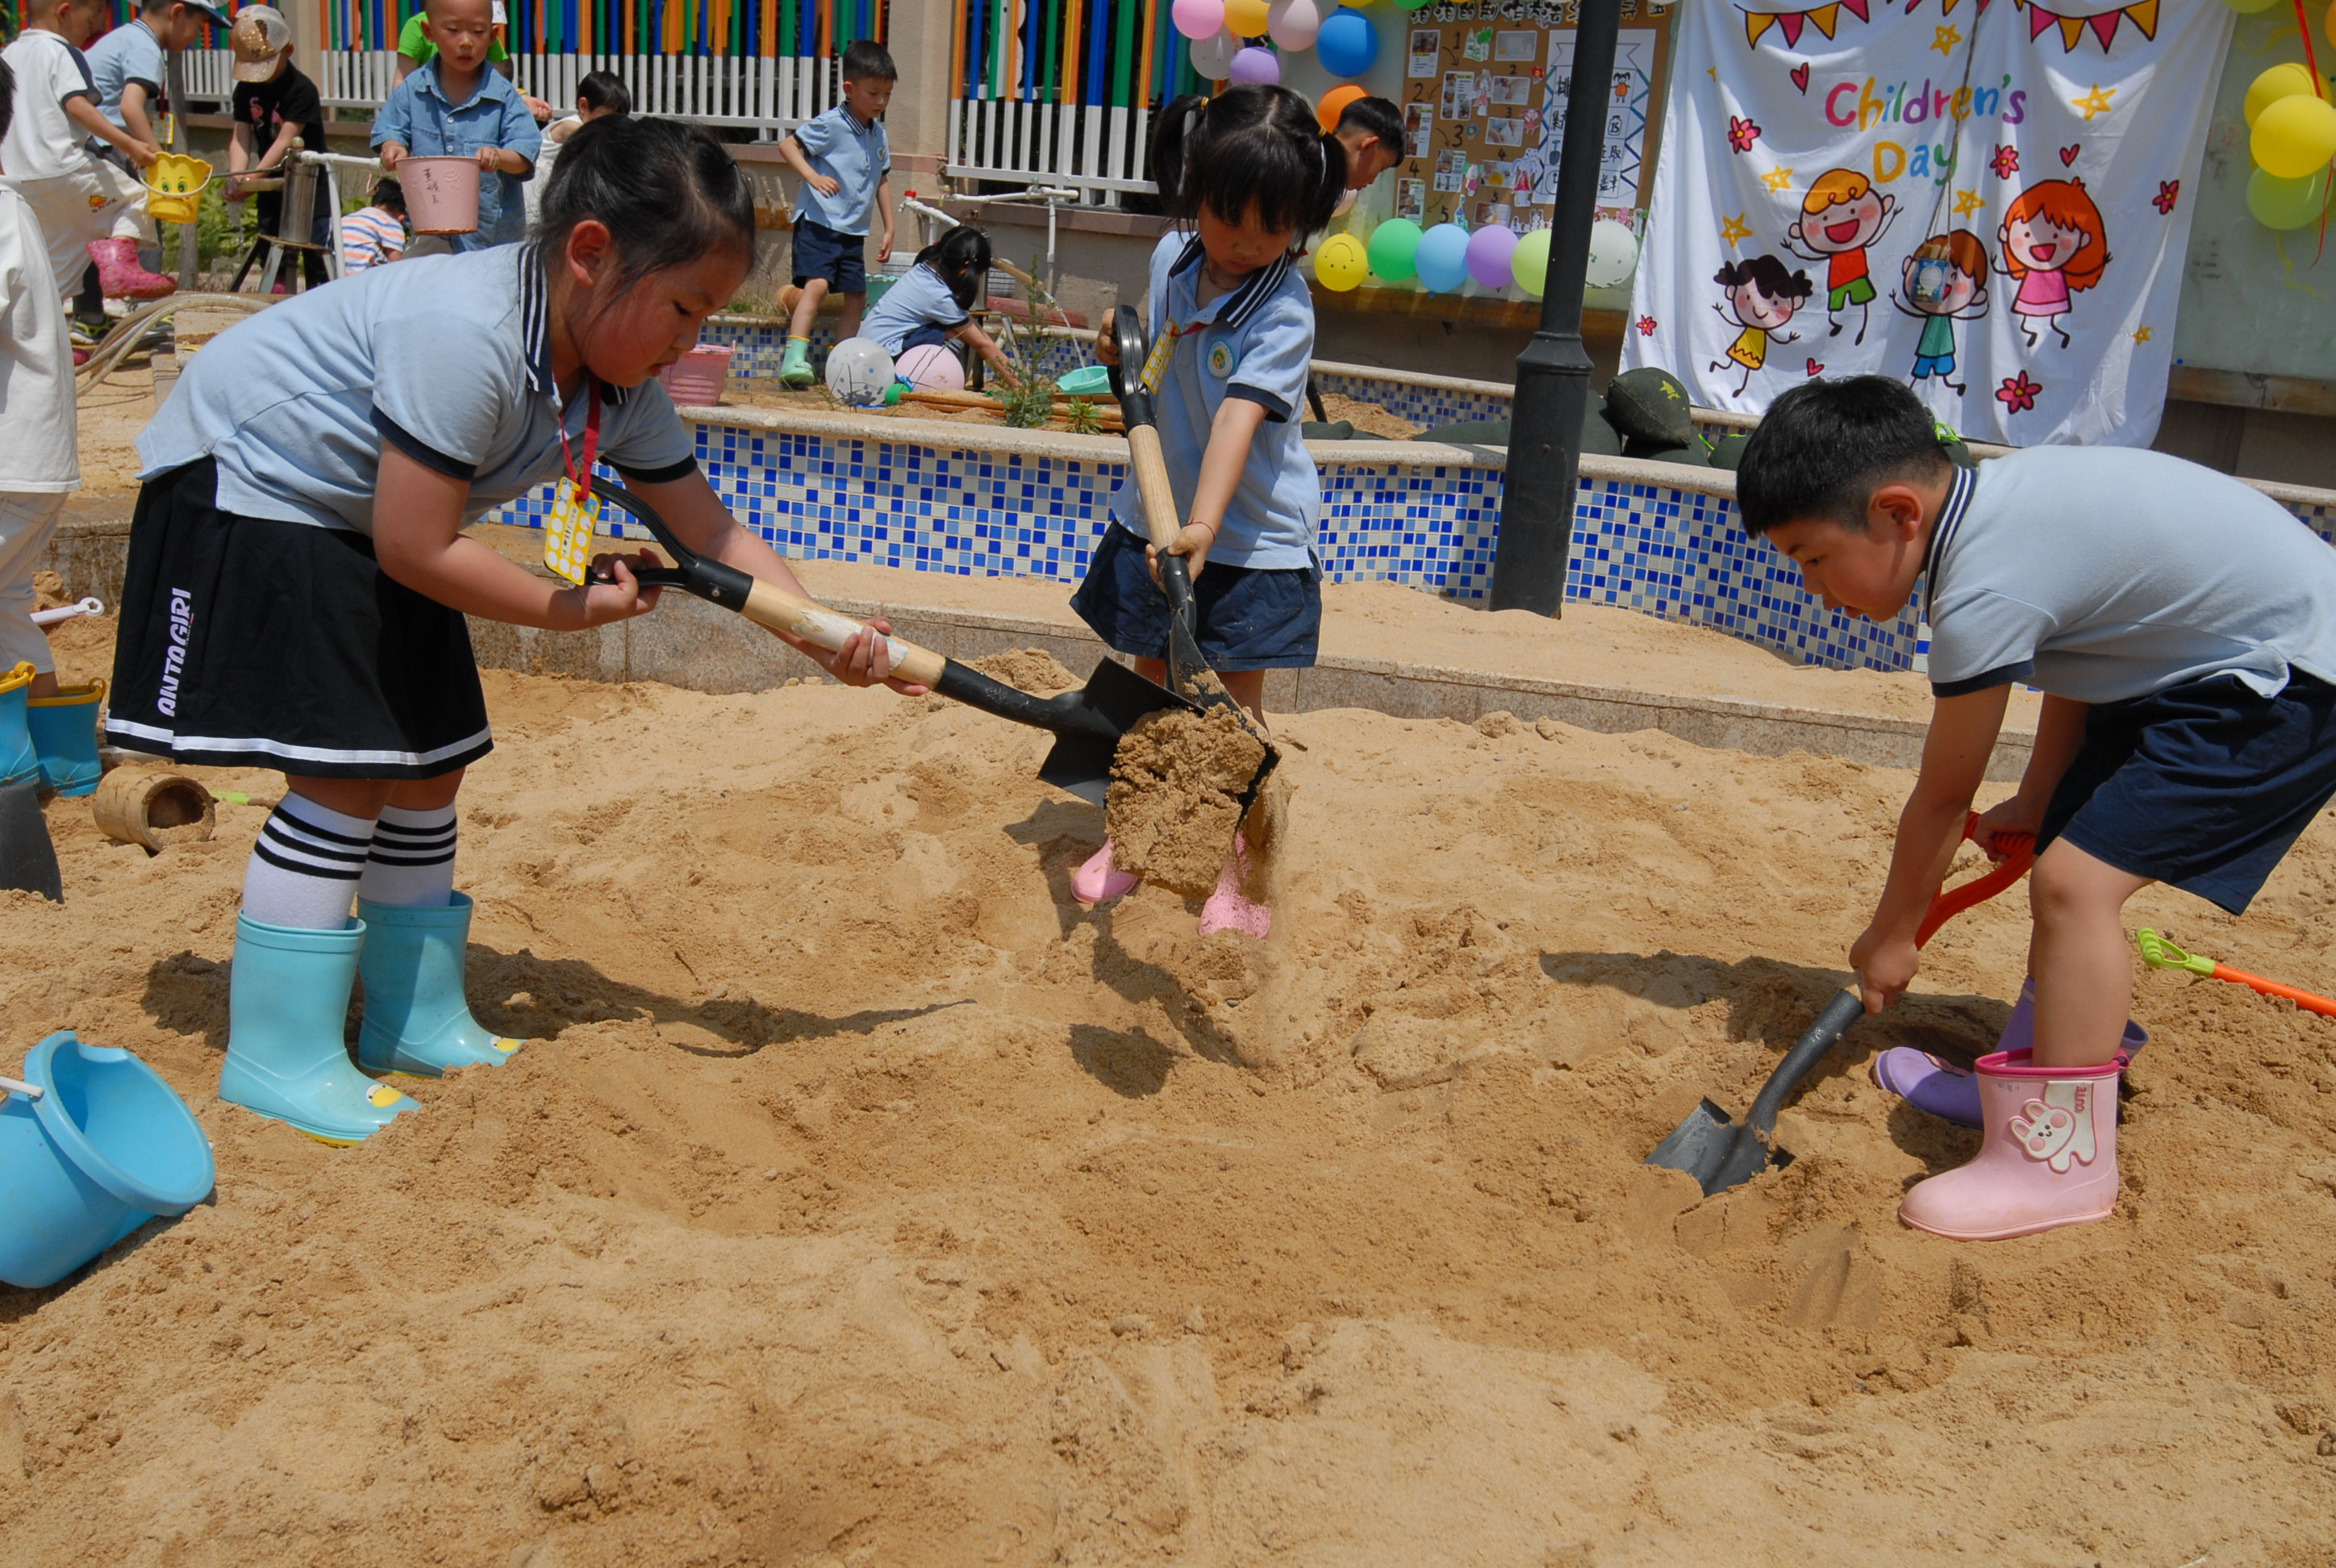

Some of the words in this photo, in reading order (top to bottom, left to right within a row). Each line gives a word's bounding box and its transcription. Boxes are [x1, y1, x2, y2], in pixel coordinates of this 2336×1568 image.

[1453, 31, 1461, 49] 1
[1509, 65, 1517, 75] 2
[1412, 82, 1424, 102] 2
[1825, 73, 2026, 131] Children's
[1505, 106, 1512, 118] 3
[1452, 124, 1464, 148] 3
[1498, 148, 1507, 161] 4
[1873, 140, 1958, 186] Day
[1408, 160, 1420, 178] 4
[1491, 190, 1499, 202] 5
[1439, 206, 1450, 223] 5
[2075, 1085, 2088, 1112] CUTE
